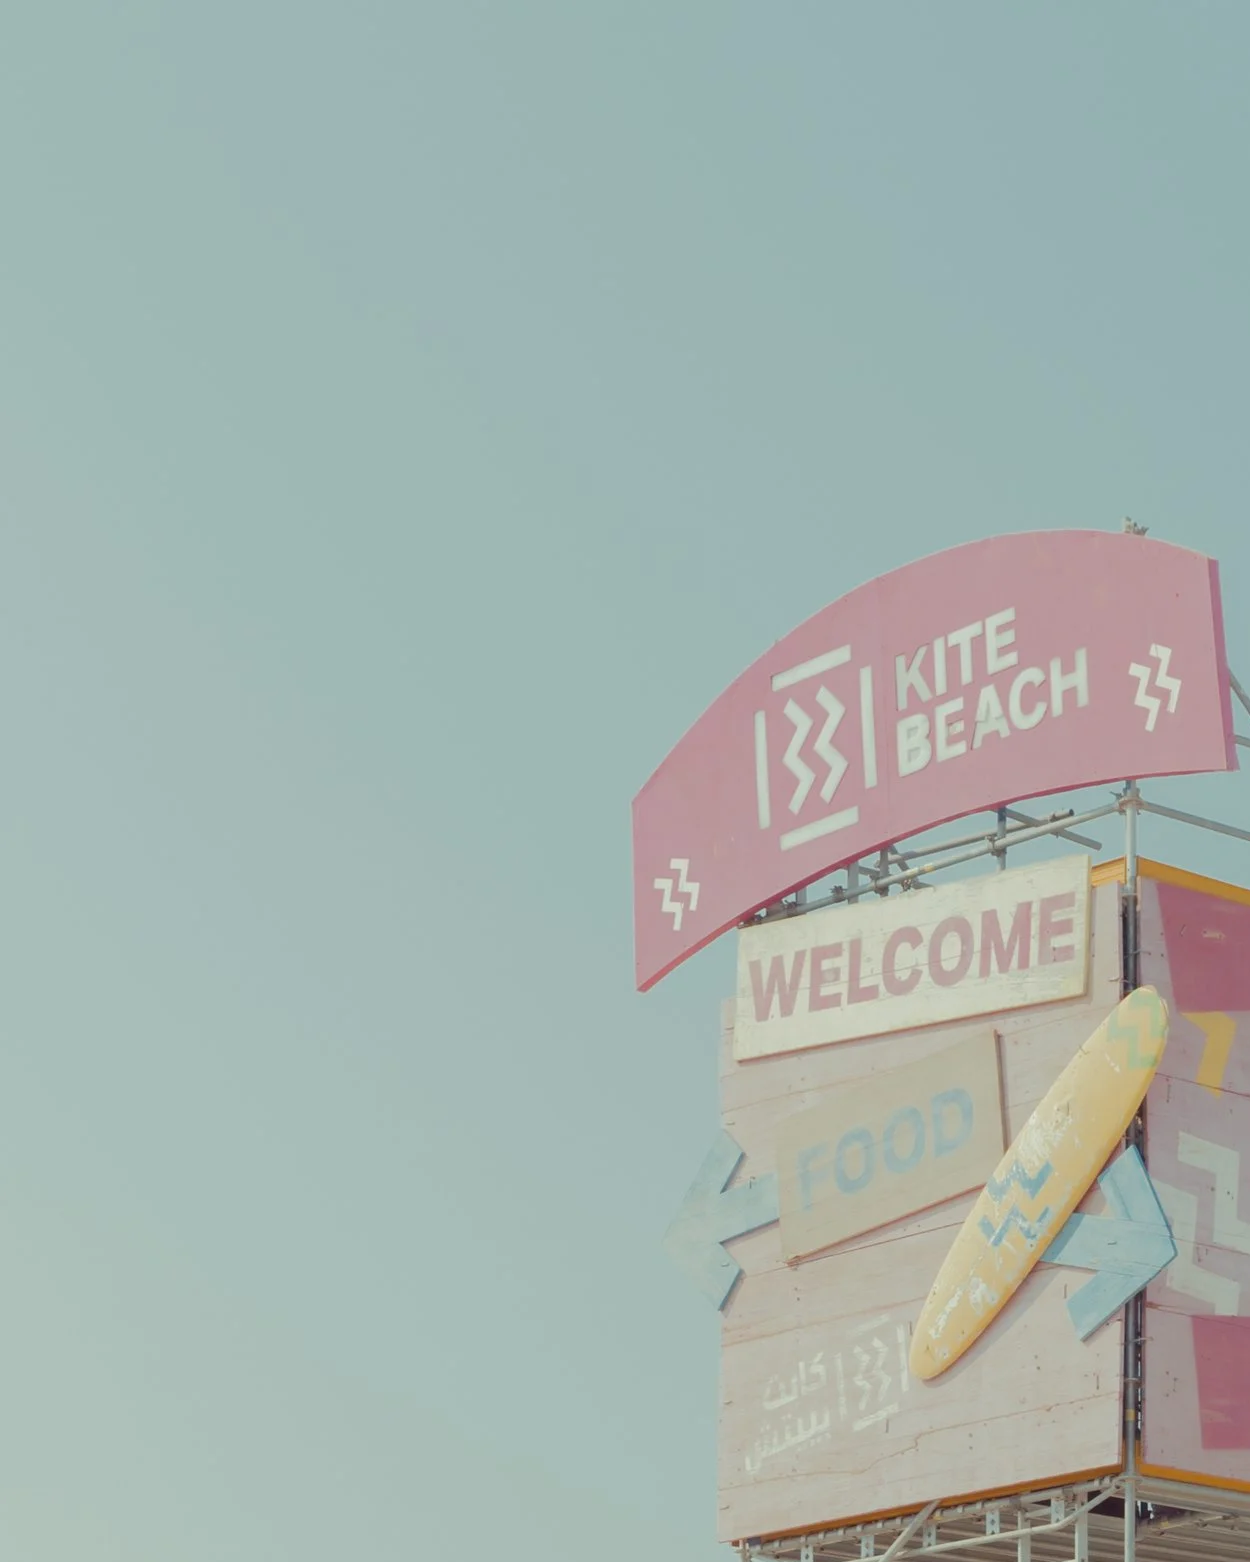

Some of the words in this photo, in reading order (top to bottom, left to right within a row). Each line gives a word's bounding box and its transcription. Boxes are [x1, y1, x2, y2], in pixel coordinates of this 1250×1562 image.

[895, 607, 1018, 711] KITE
[896, 646, 1089, 777] BEACH
[748, 891, 1075, 1023] WELCOME
[797, 1087, 974, 1211] FOOD
